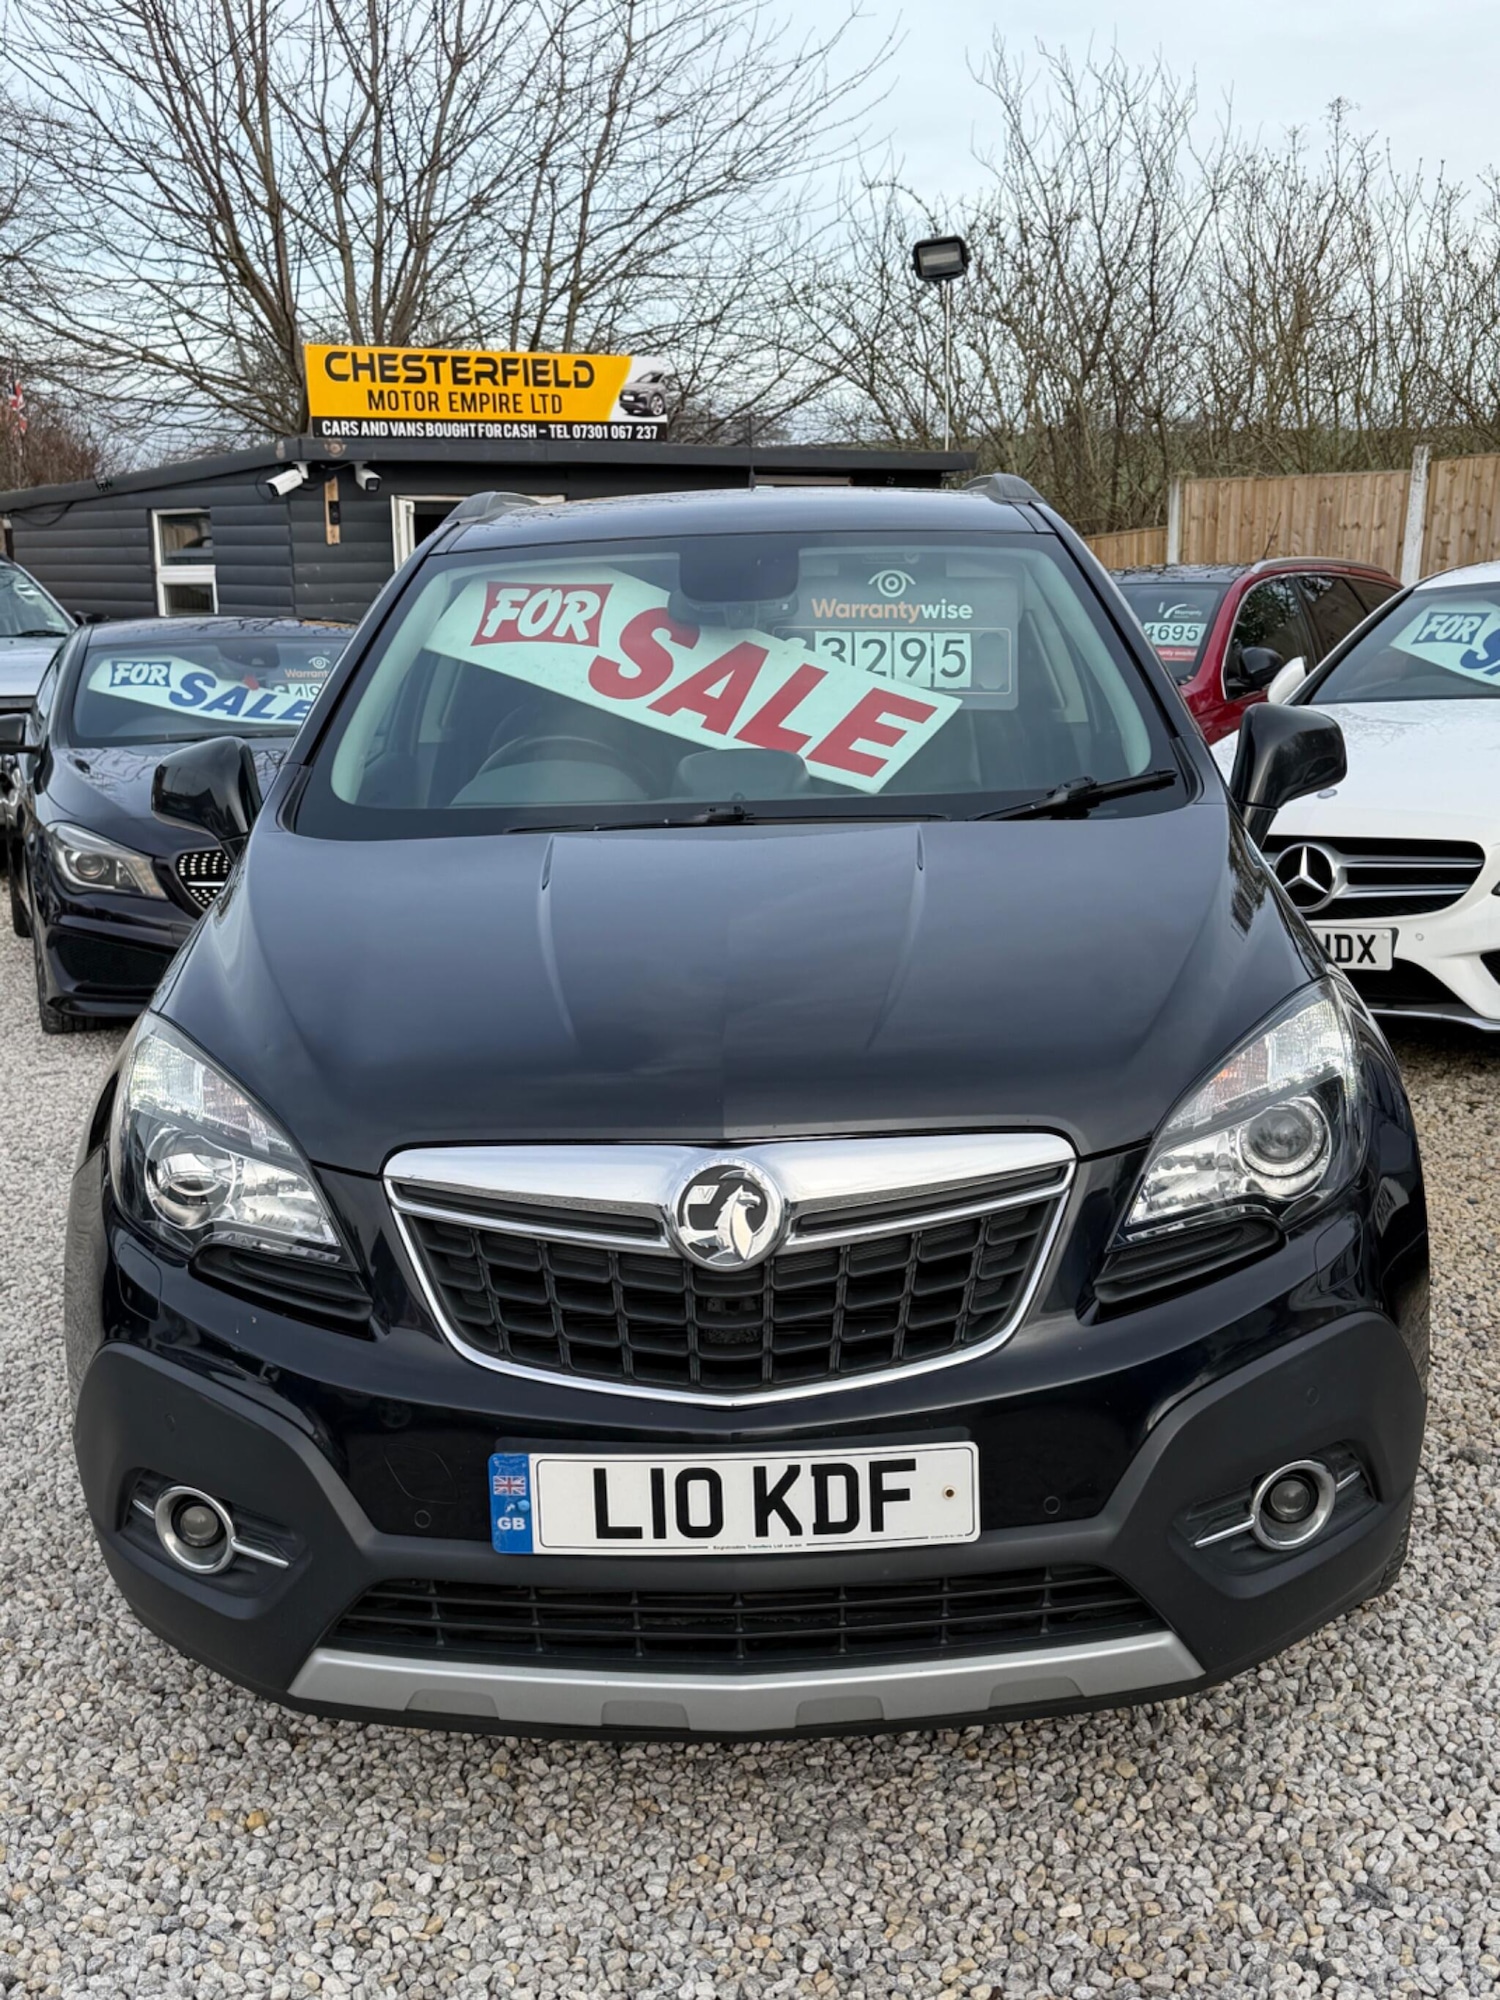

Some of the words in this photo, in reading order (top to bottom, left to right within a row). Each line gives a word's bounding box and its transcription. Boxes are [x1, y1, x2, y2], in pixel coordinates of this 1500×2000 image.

[325, 351, 595, 389] CHESTERFIELD
[367, 389, 440, 412] MOTOR
[448, 391, 523, 414] EMPIRE
[530, 393, 562, 414] LTD
[322, 420, 359, 436] CARS
[361, 421, 388, 437] AND
[389, 422, 425, 438] VANS
[426, 422, 477, 438] BOUGHT
[478, 423, 503, 438] FOR
[504, 423, 537, 439] CASH
[548, 424, 571, 439] TEL
[572, 424, 608, 439] 07301
[611, 425, 632, 439] 067
[636, 425, 658, 440] 237
[811, 598, 973, 623] Warrantywise
[1145, 624, 1200, 641] 4695
[1417, 614, 1483, 642] FOR
[785, 637, 967, 678] 3295
[112, 661, 170, 686] FOR
[481, 587, 602, 646] FOR
[587, 607, 937, 778] SALE
[752, 1458, 917, 1538] KDF
[497, 1516, 526, 1530] GB
